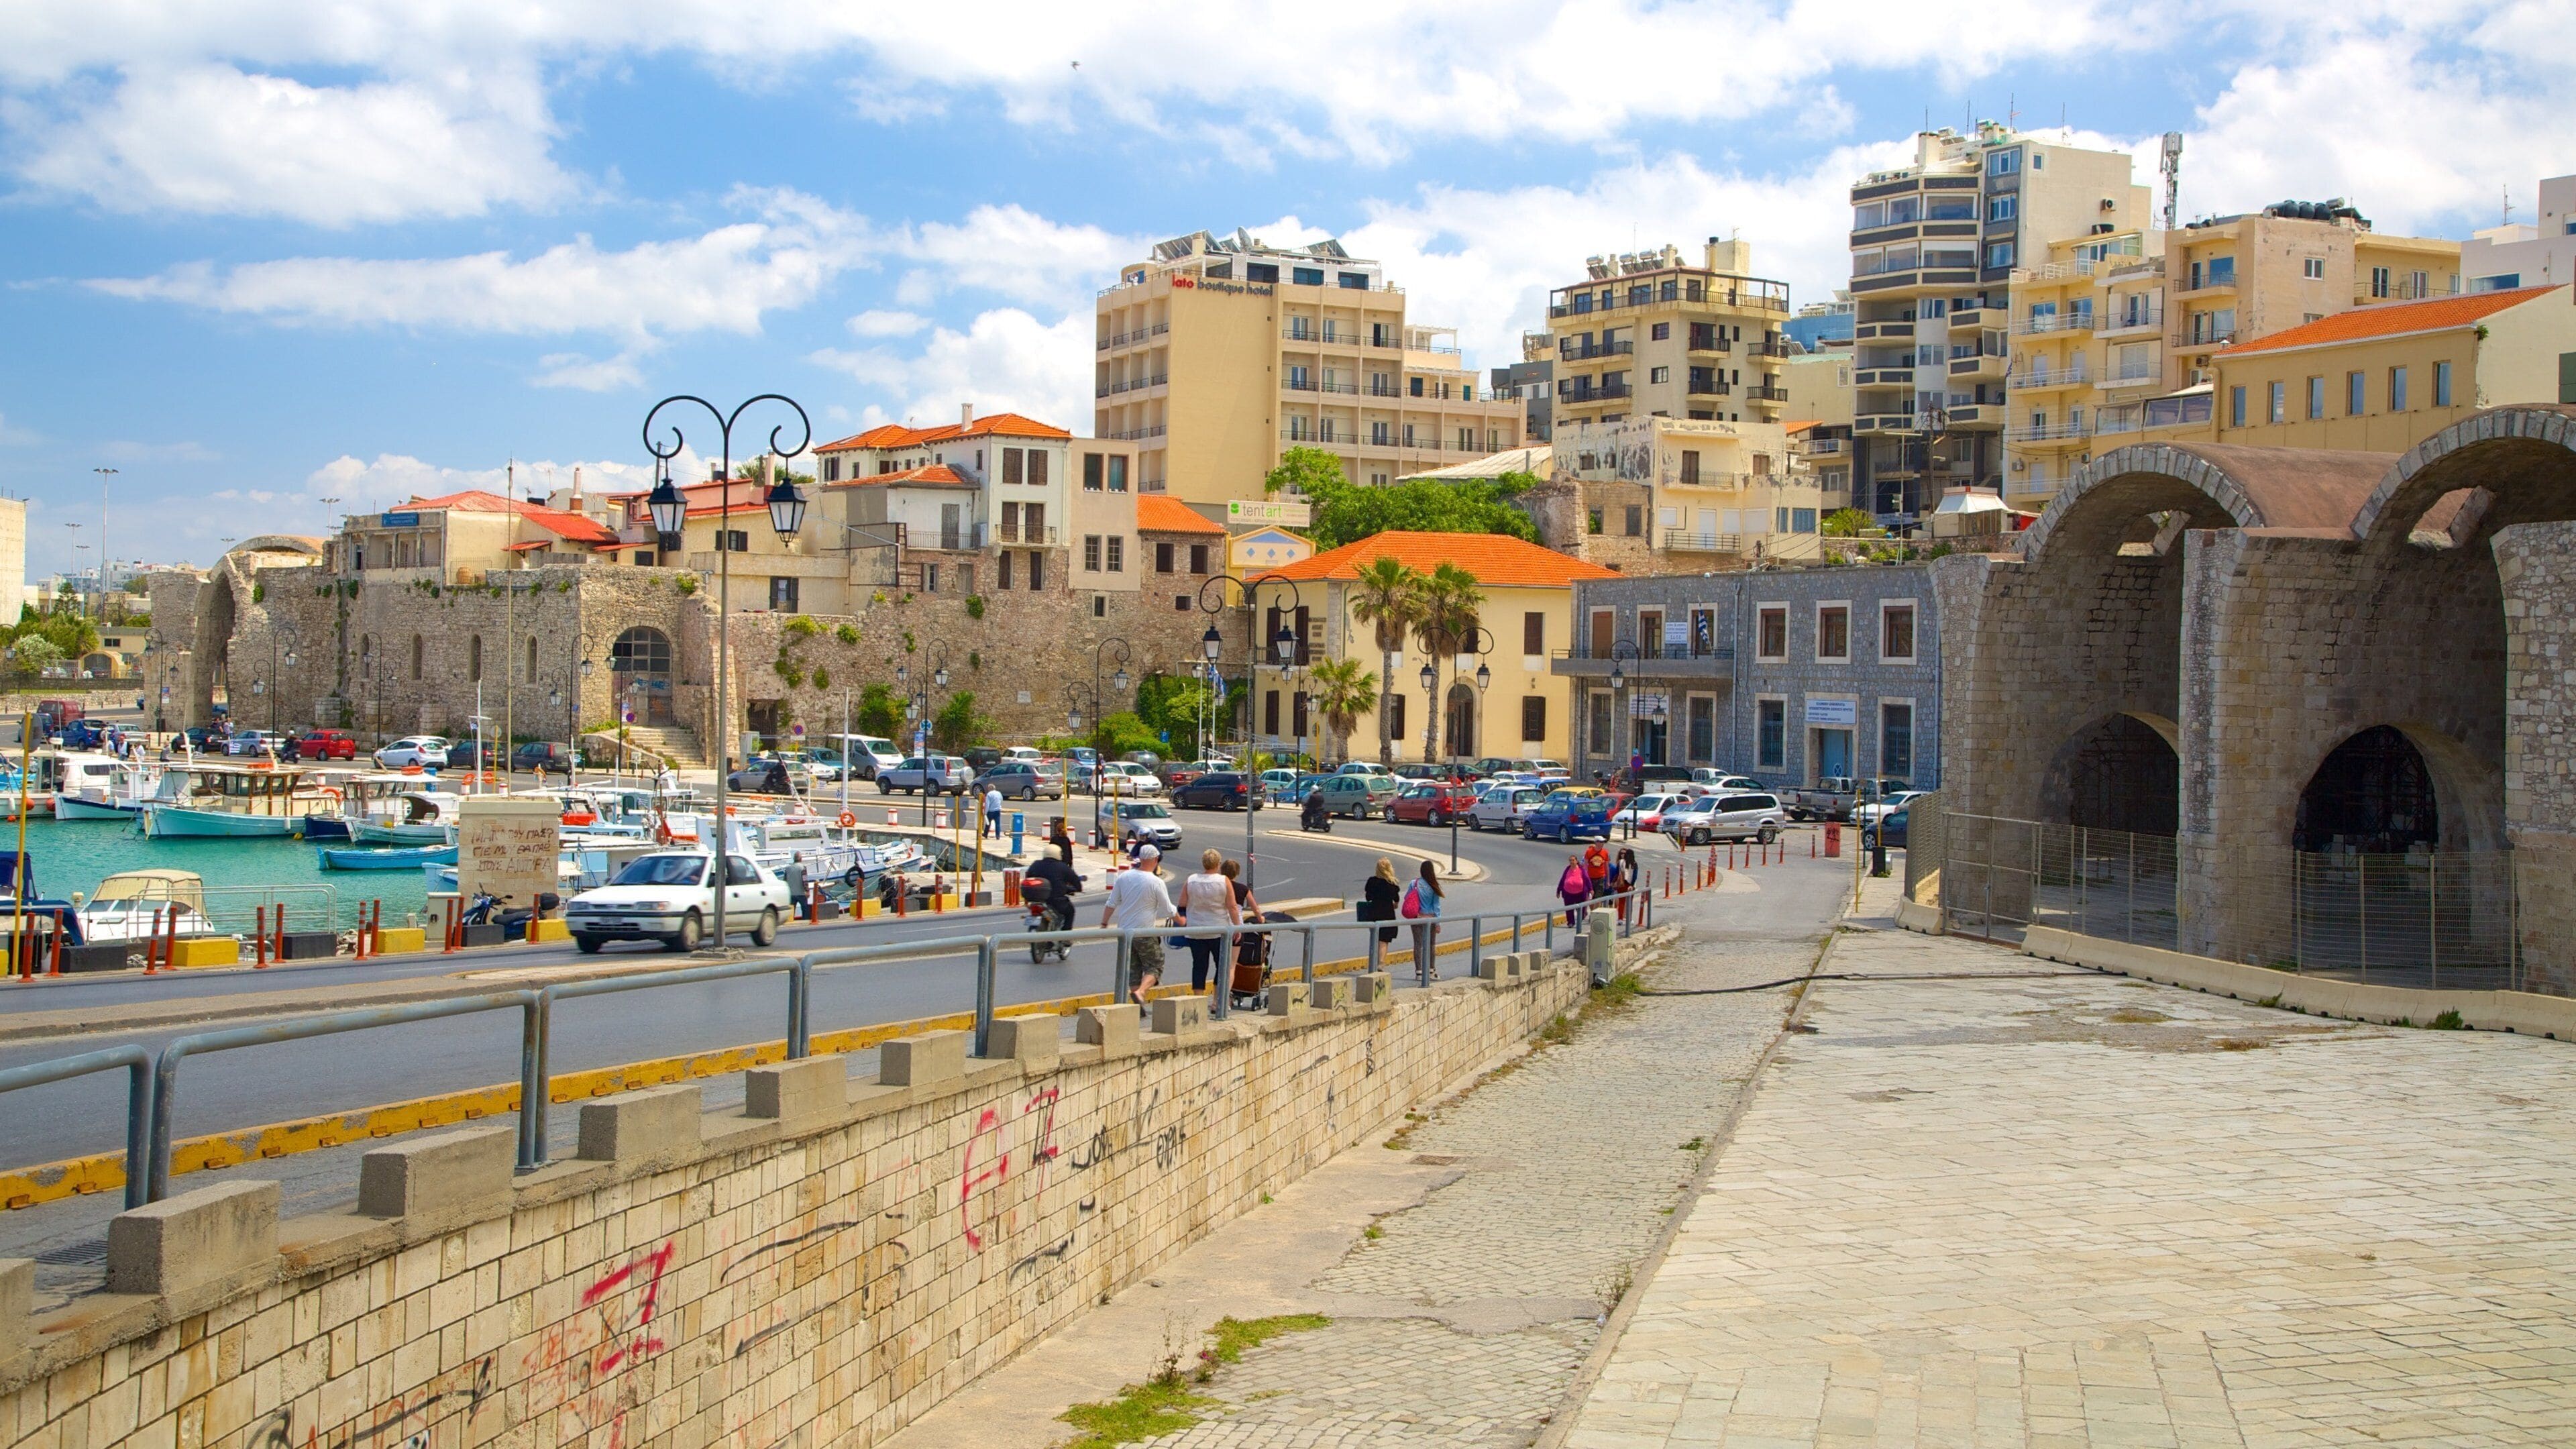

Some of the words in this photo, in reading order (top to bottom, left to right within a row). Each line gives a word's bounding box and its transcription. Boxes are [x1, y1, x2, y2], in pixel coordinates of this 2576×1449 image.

[1172, 274, 1194, 288] lato
[1197, 277, 1244, 296] boutique
[1246, 282, 1273, 297] hotel
